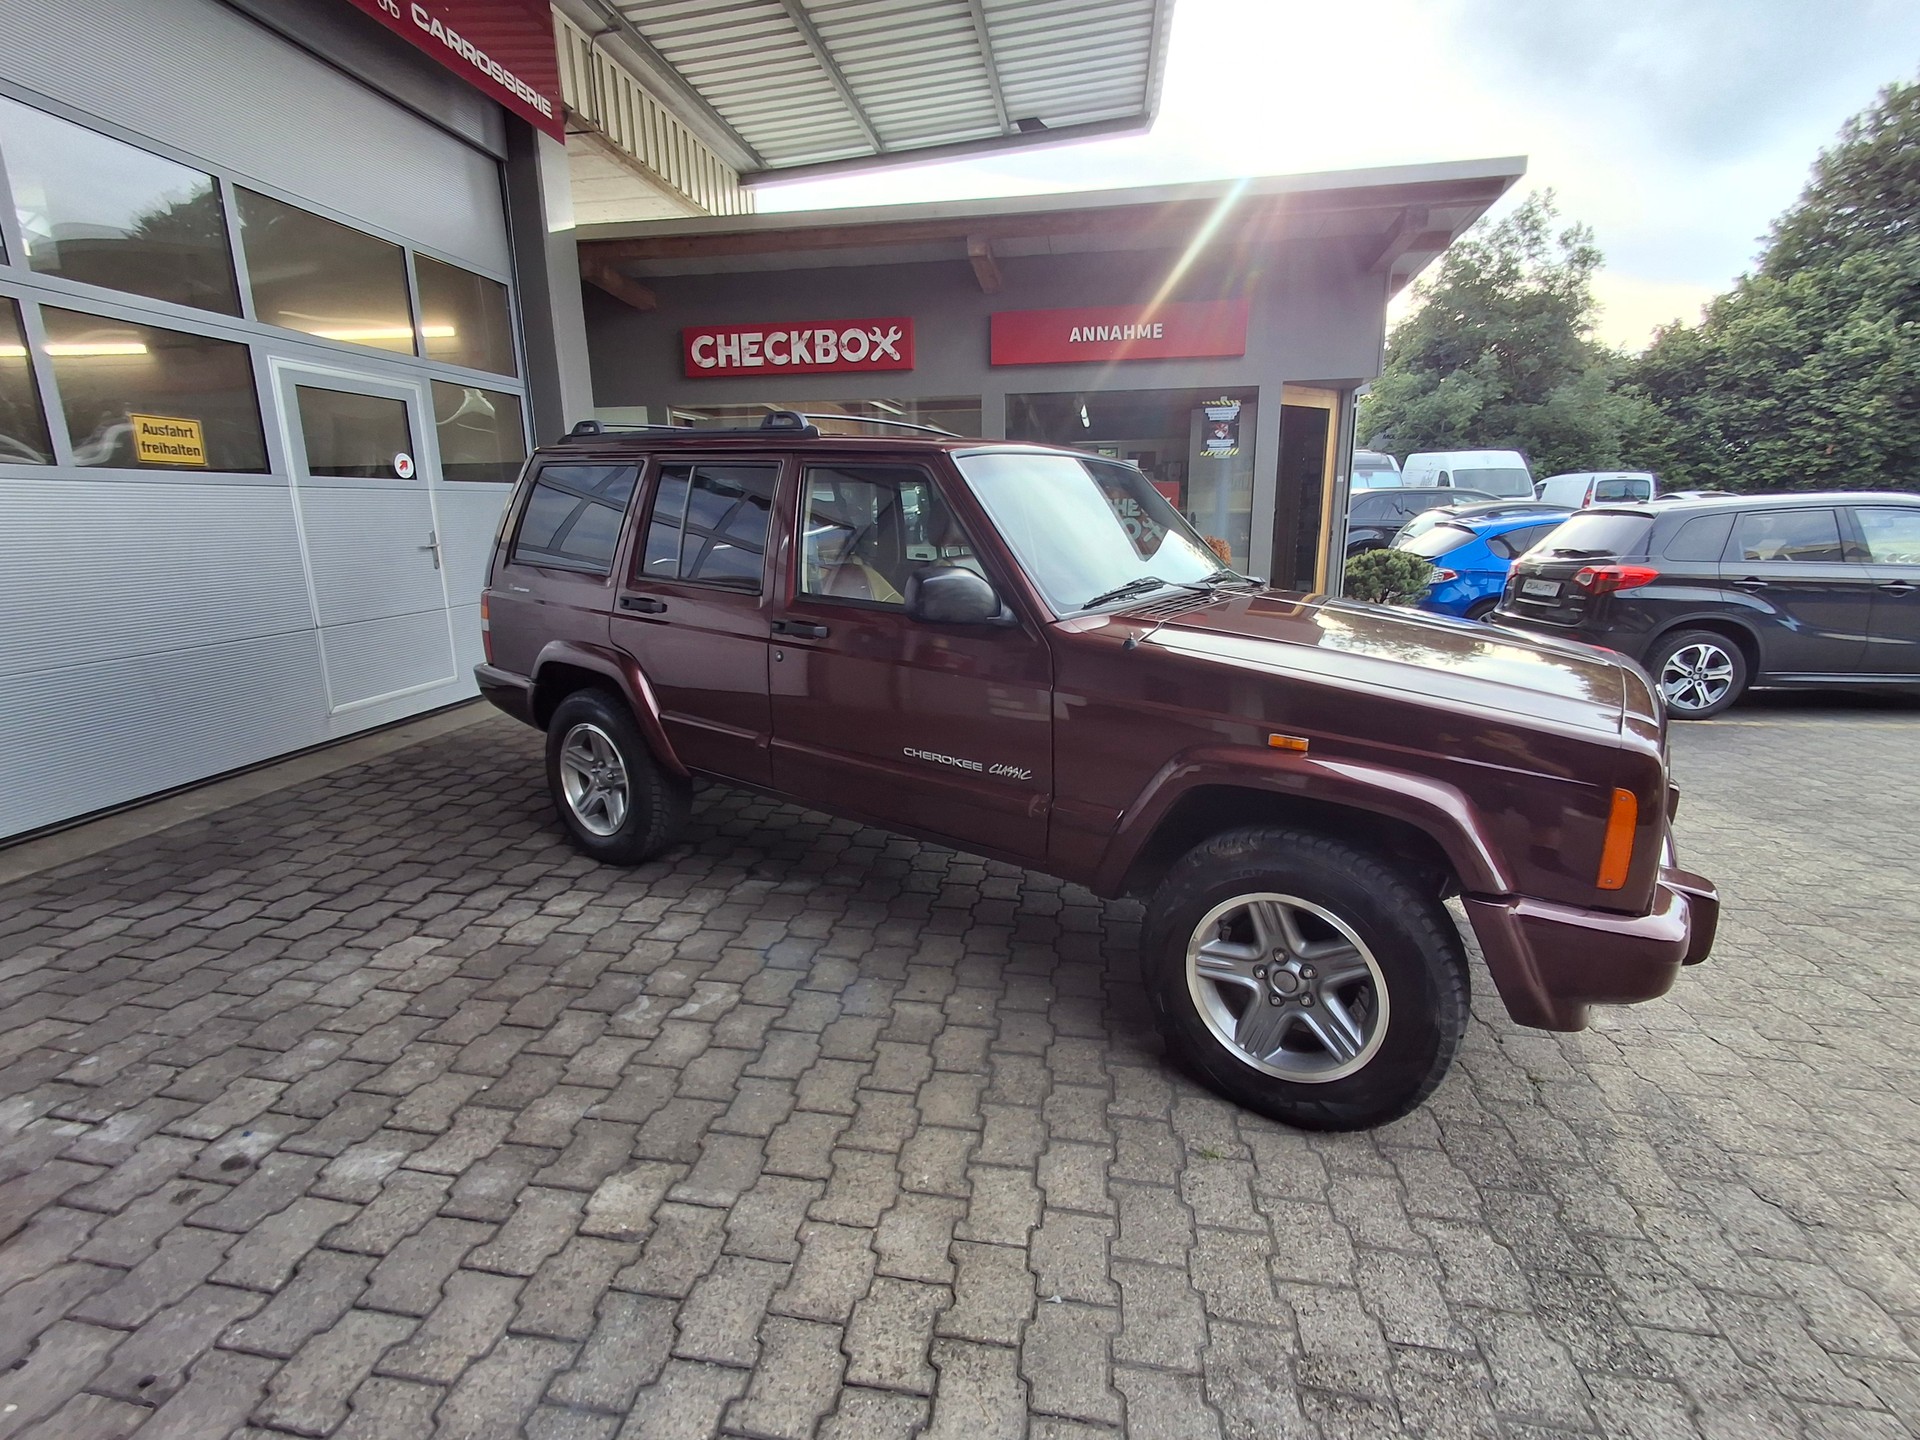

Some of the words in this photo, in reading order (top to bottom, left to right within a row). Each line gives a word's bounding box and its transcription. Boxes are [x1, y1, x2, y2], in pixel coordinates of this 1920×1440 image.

[411, 3, 553, 119] CARROSSERIE
[1069, 323, 1163, 343] ANNAHME
[691, 326, 902, 368] CHECKBOX
[142, 423, 194, 439] Ausfahrt
[141, 441, 201, 457] freihalten
[903, 747, 983, 772] CHEROKEE
[988, 763, 1032, 781] CLASSIC
